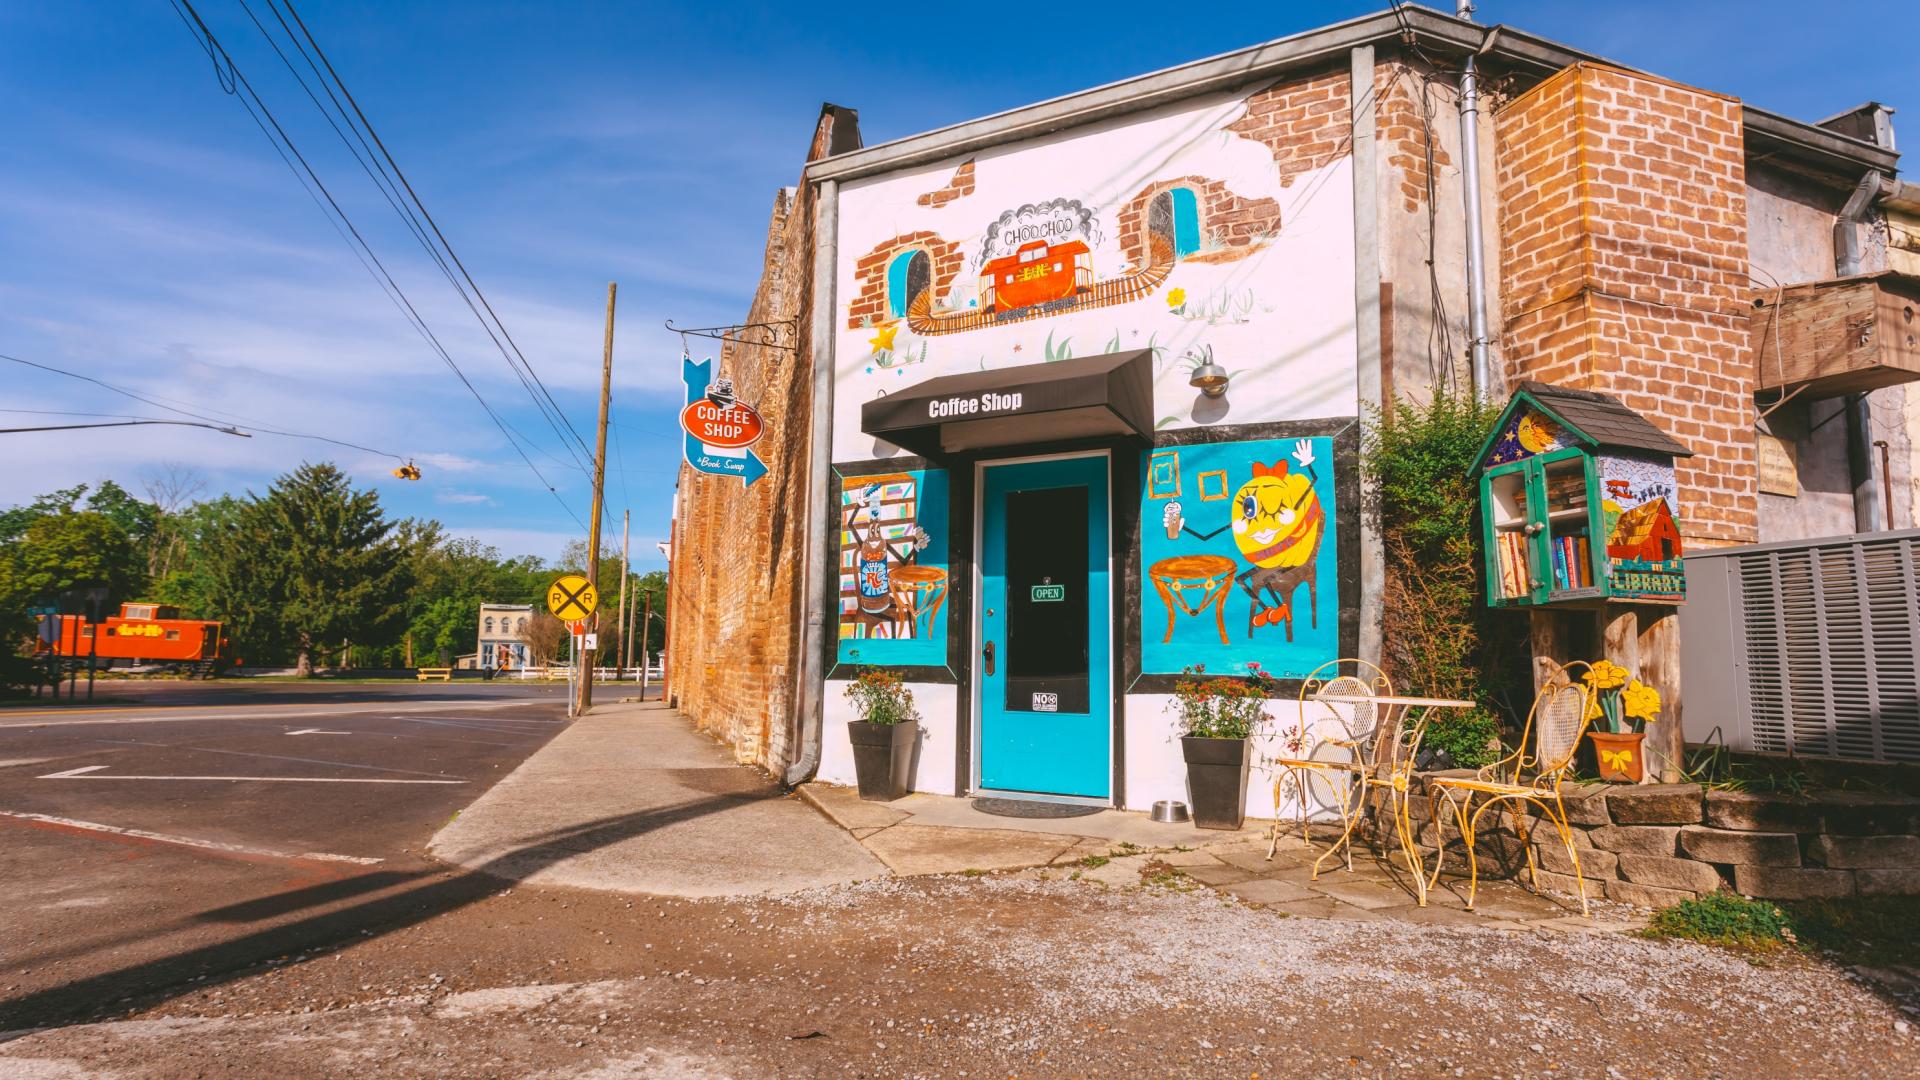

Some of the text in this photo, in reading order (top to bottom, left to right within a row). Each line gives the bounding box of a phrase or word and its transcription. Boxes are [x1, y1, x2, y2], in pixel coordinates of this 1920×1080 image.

[1005, 219, 1072, 245] CHOO CHOO
[928, 392, 1022, 418] Coffee Shop
[697, 406, 750, 424] COFFEE
[704, 423, 742, 438] SHOP
[701, 456, 721, 468] Book
[724, 459, 745, 473] Swap
[1613, 572, 1687, 592] LIBRARY
[552, 593, 593, 603] R R
[1036, 588, 1059, 599] OPEN
[1034, 694, 1048, 704] NO
